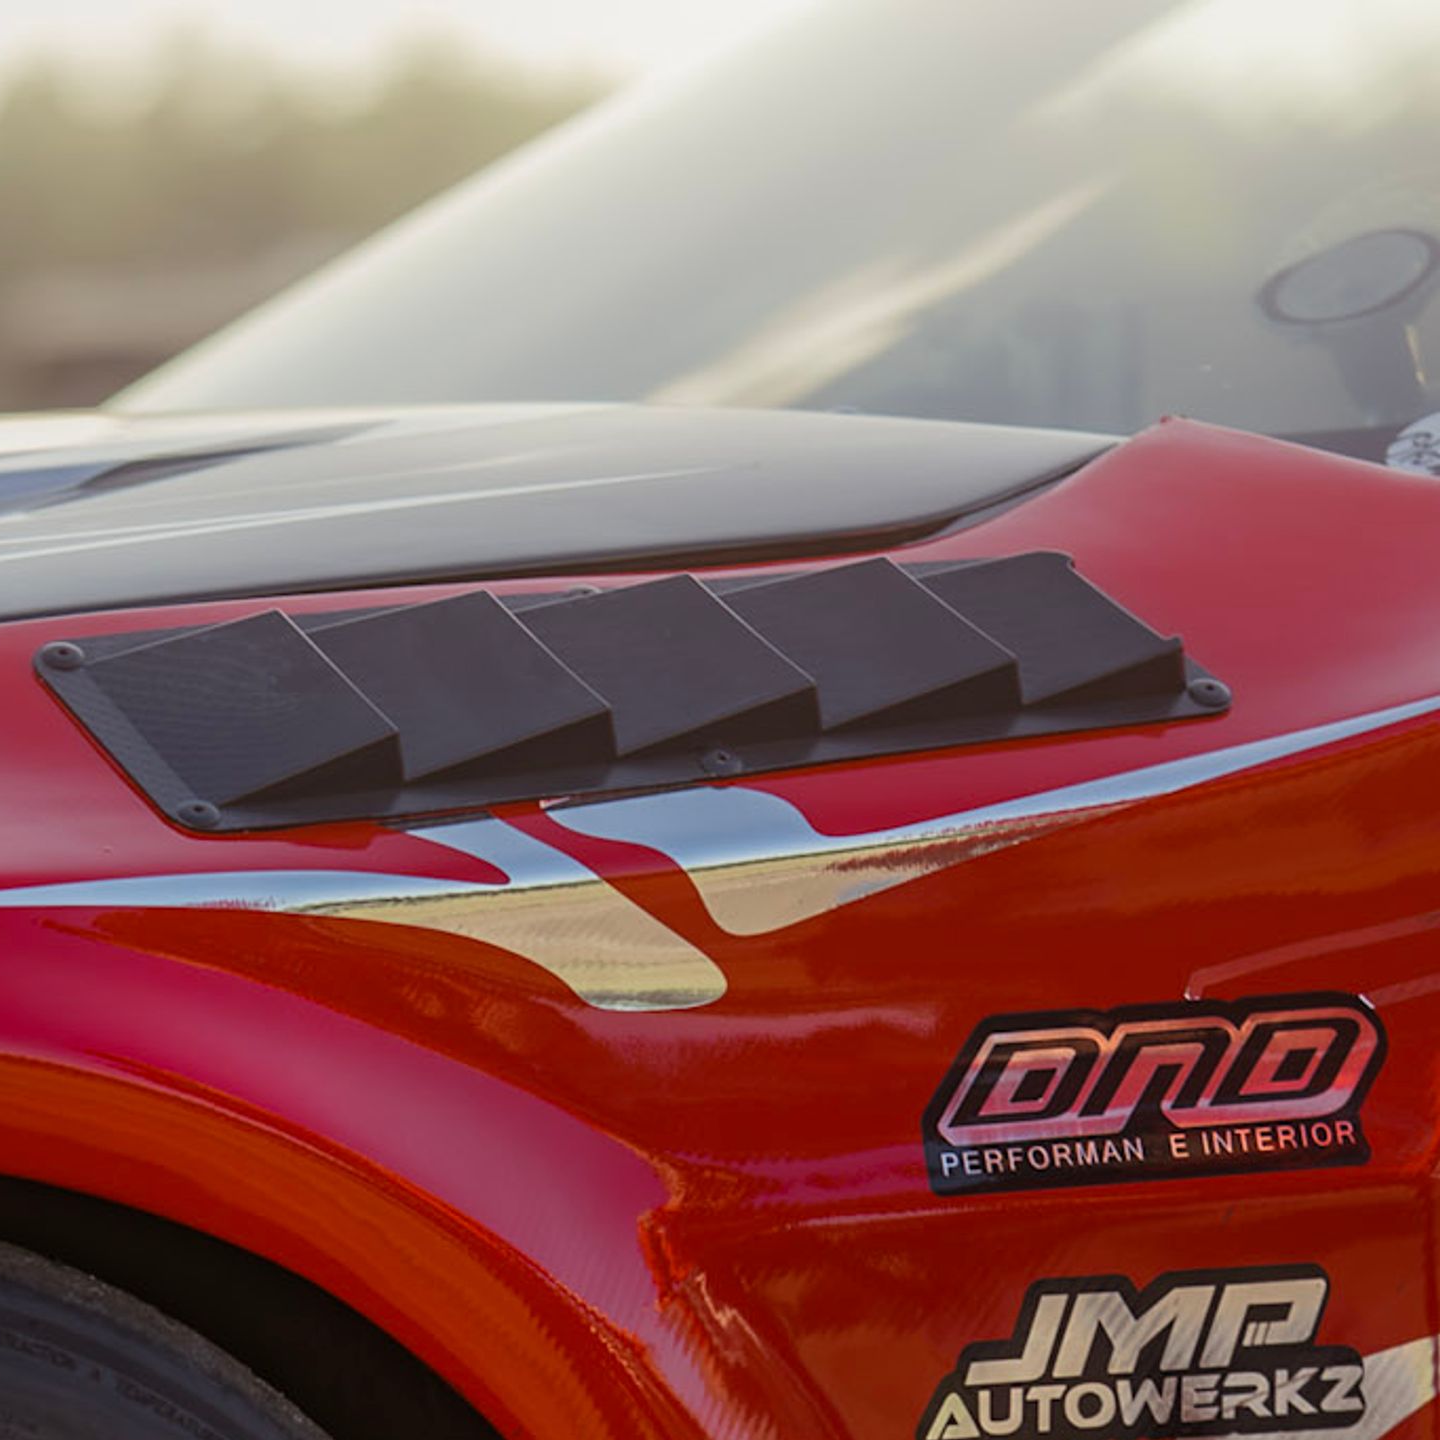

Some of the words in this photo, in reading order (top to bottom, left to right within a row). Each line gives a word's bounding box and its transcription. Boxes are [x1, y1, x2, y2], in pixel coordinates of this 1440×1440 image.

[940, 1137, 1191, 1178] PERFORMANE
[1201, 1119, 1358, 1157] INTERIOR
[964, 1277, 1328, 1387] JMP
